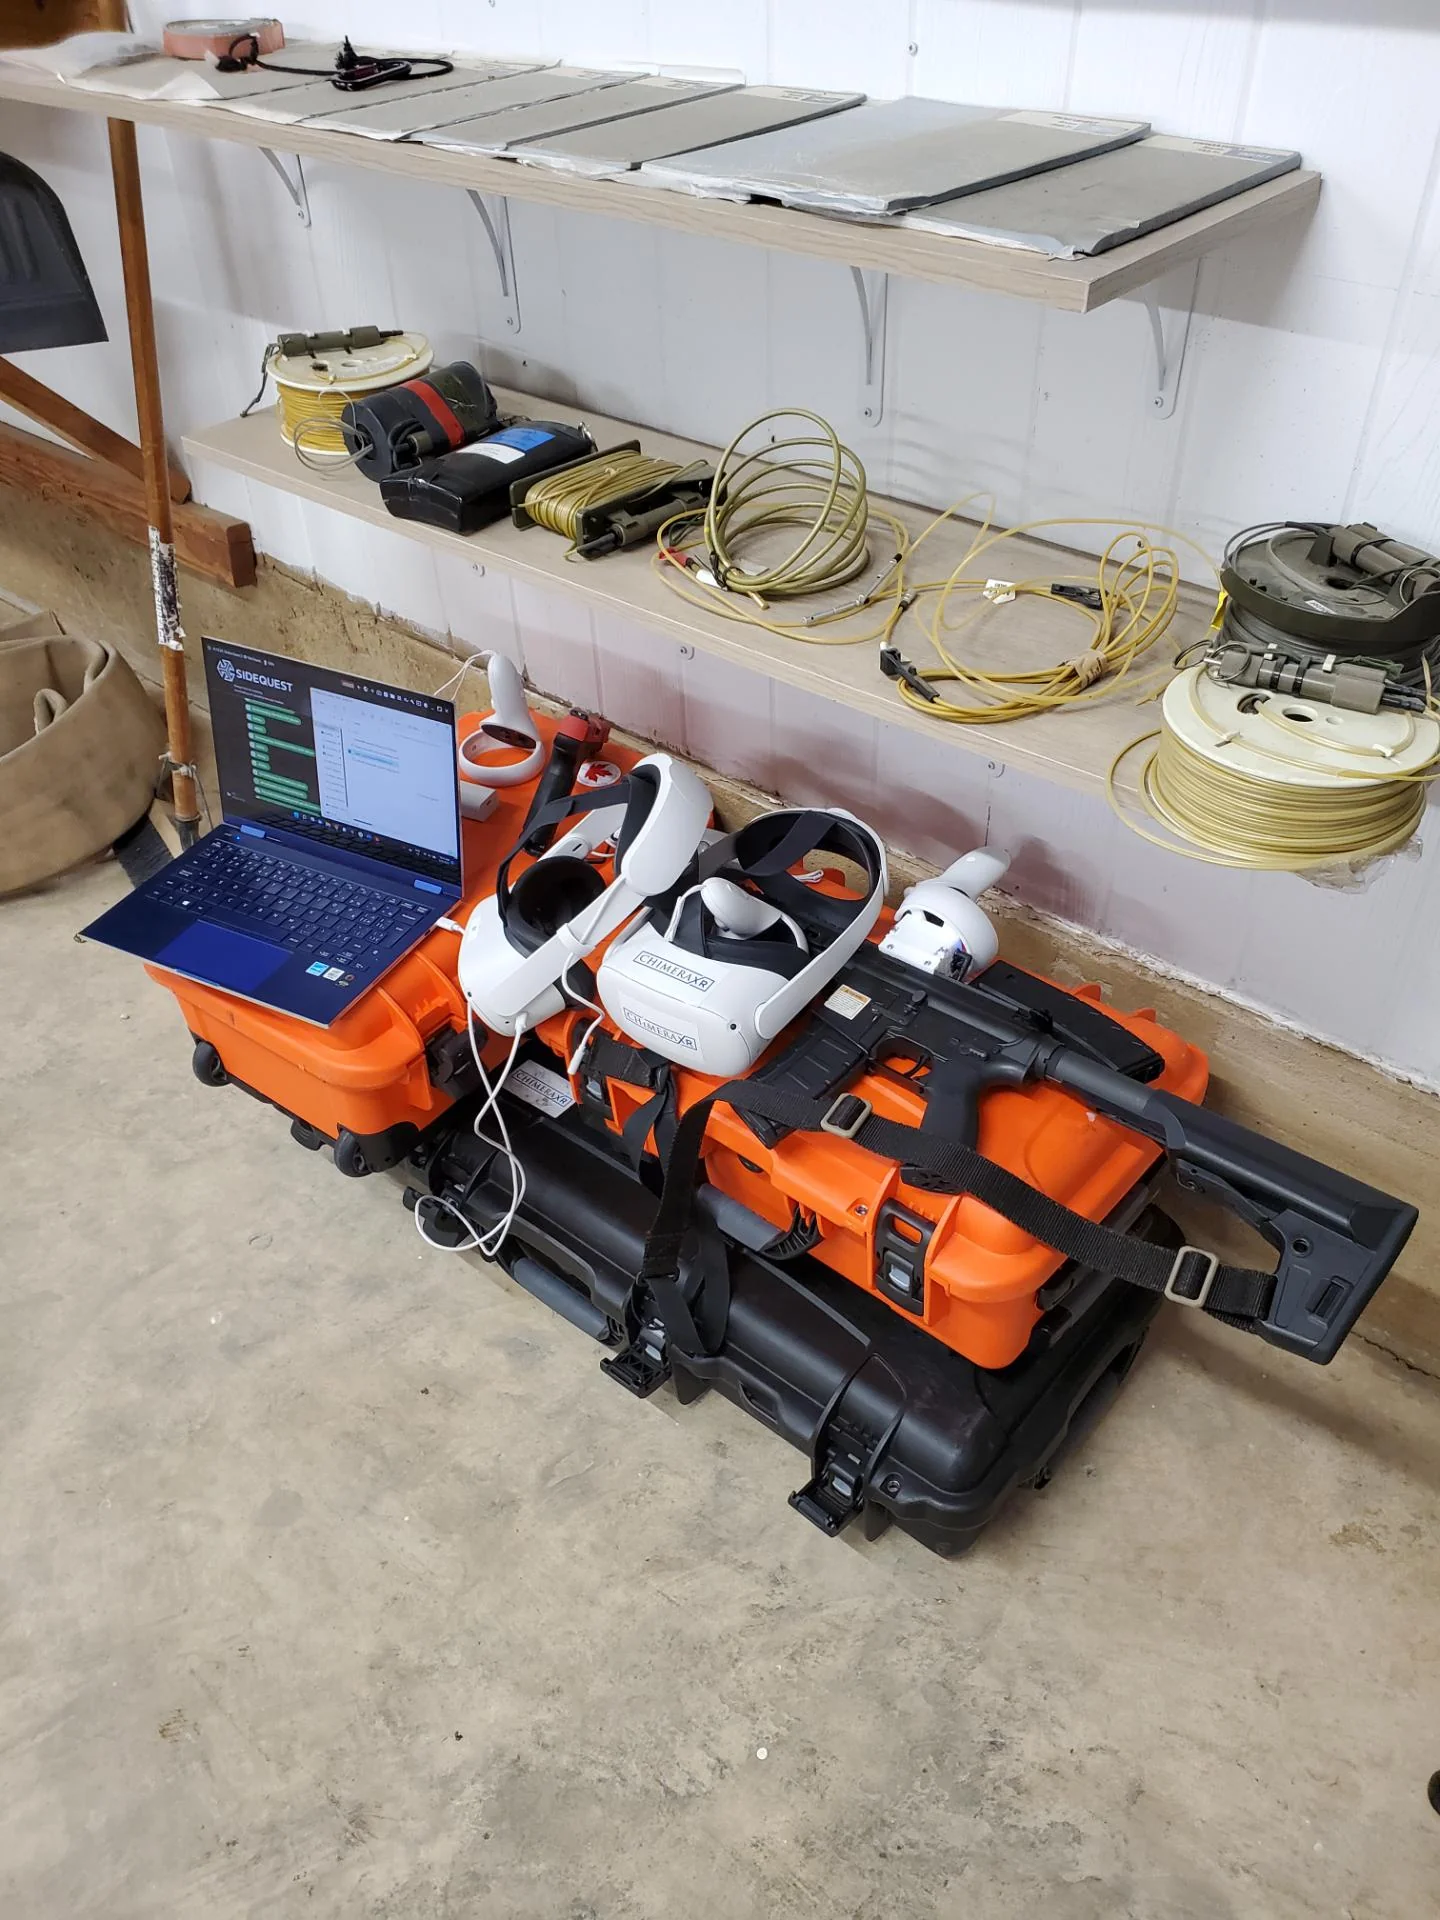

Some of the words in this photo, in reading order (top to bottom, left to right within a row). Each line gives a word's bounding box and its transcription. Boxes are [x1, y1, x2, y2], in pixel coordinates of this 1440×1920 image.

[235, 668, 293, 692] SIDEQUEST
[639, 954, 710, 989] CHIMERAXR
[626, 1011, 693, 1047] CHIMERAXR
[516, 1071, 568, 1106] CHIMERAXR
